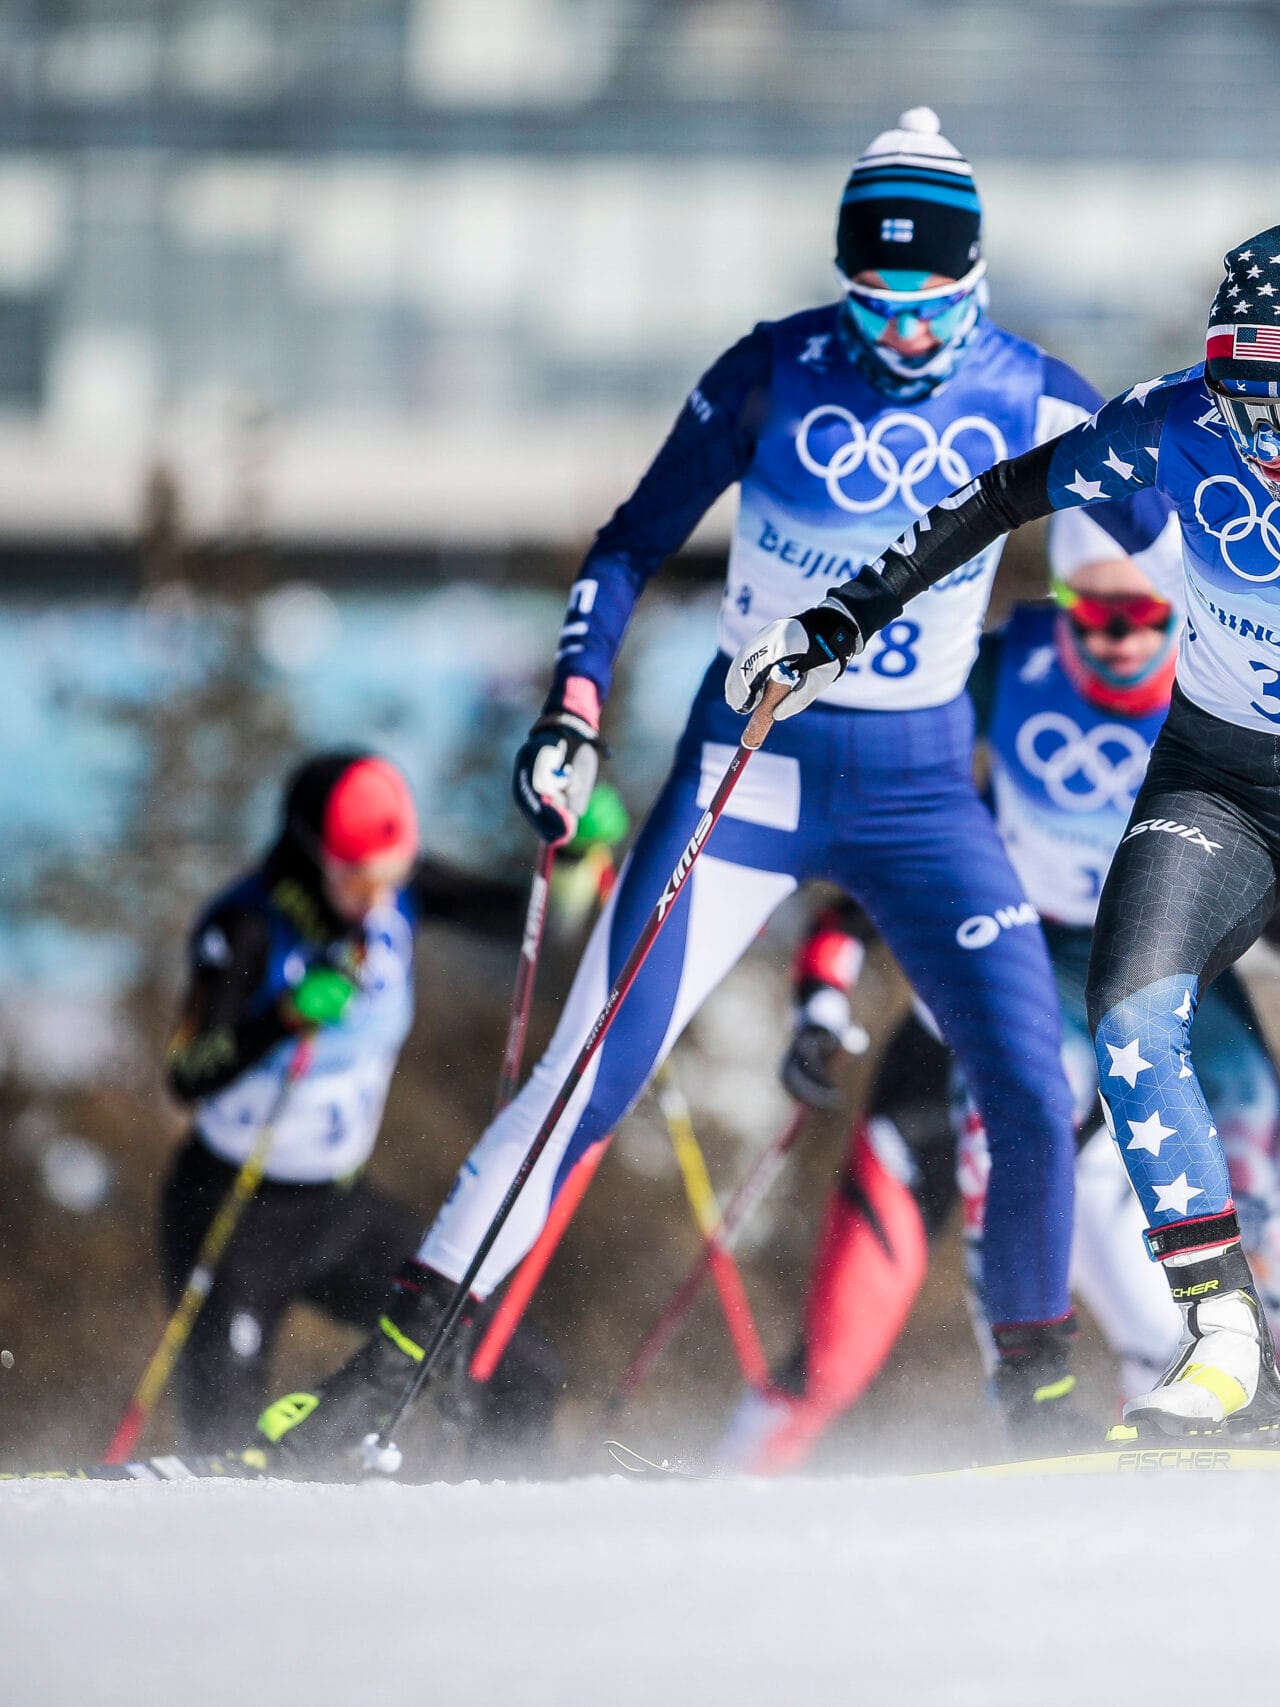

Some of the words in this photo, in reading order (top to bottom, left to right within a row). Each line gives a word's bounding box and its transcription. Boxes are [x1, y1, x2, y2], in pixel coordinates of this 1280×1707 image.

[757, 519, 868, 579] BEIJIN
[1170, 1279, 1219, 1298] CHER
[1116, 1451, 1231, 1472] FISCHER
